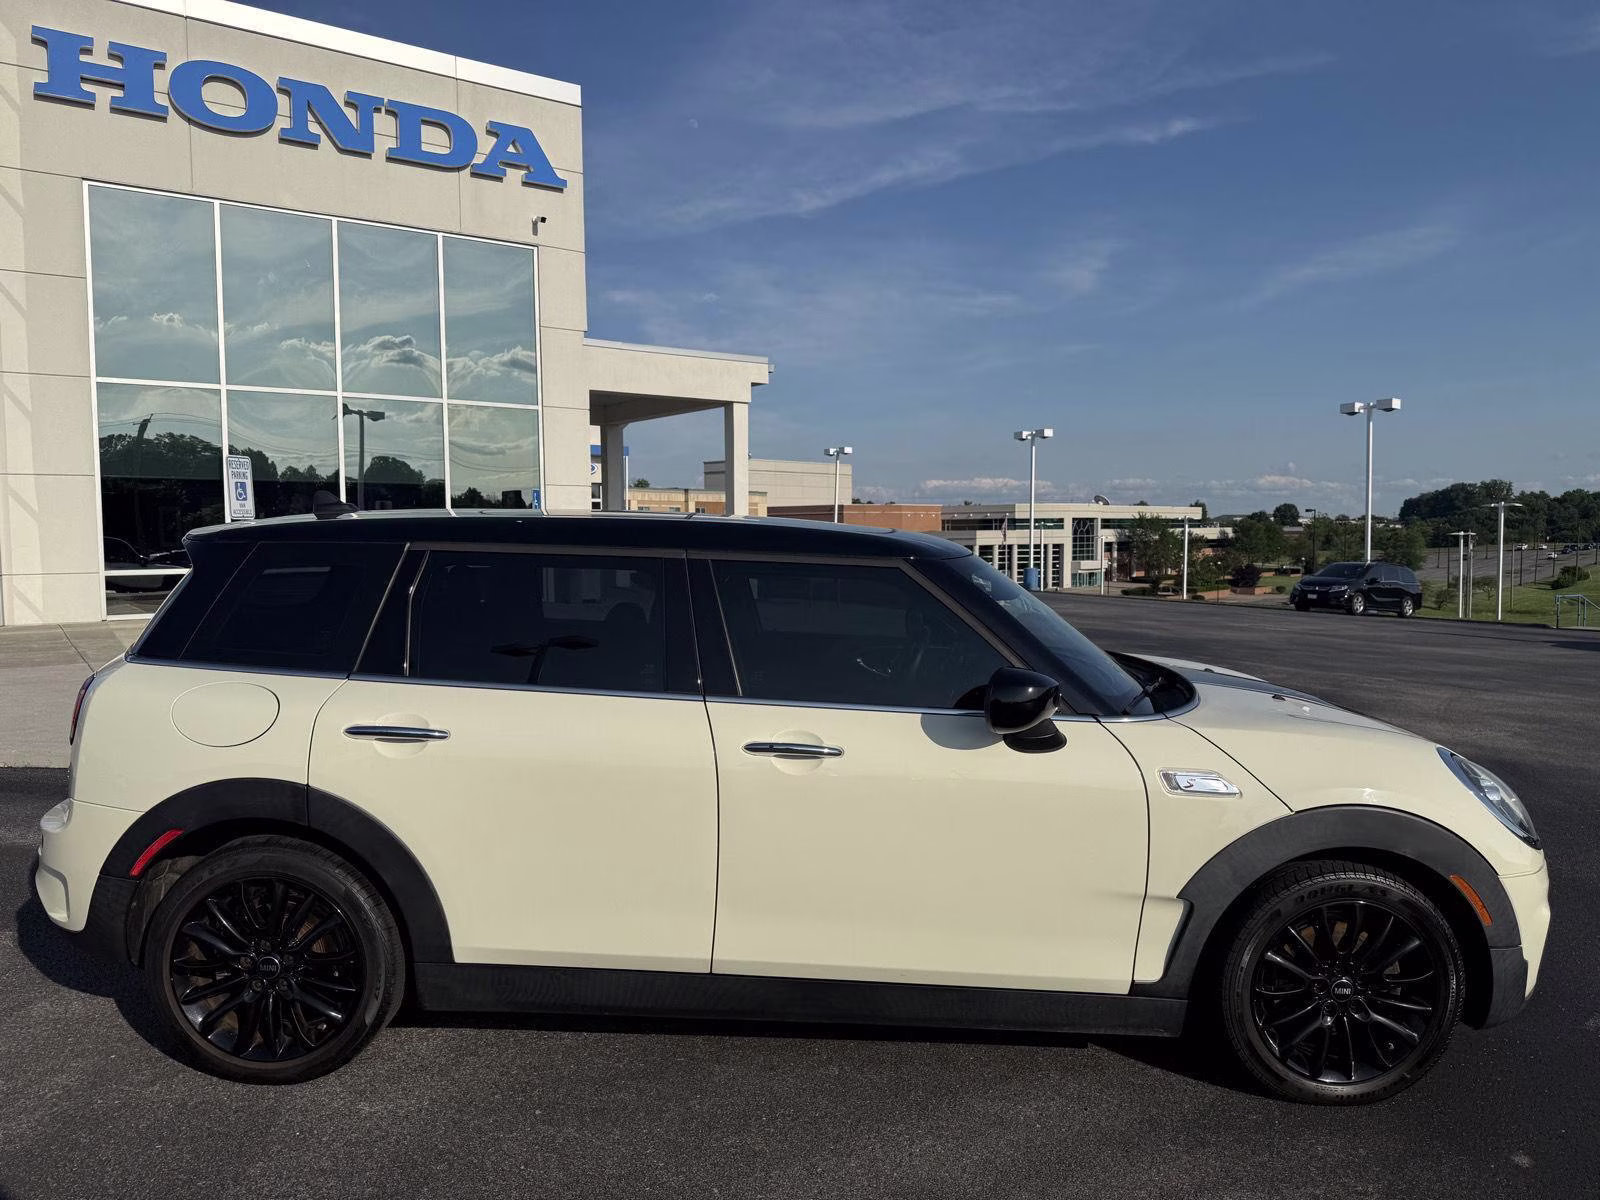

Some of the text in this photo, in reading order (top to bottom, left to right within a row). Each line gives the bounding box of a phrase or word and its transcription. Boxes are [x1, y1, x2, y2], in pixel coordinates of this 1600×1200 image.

[31, 25, 567, 189] HONDA
[228, 459, 250, 471] RESERVED
[231, 470, 249, 480] PARKING
[260, 964, 277, 972] MINI
[1335, 987, 1351, 995] MINI
